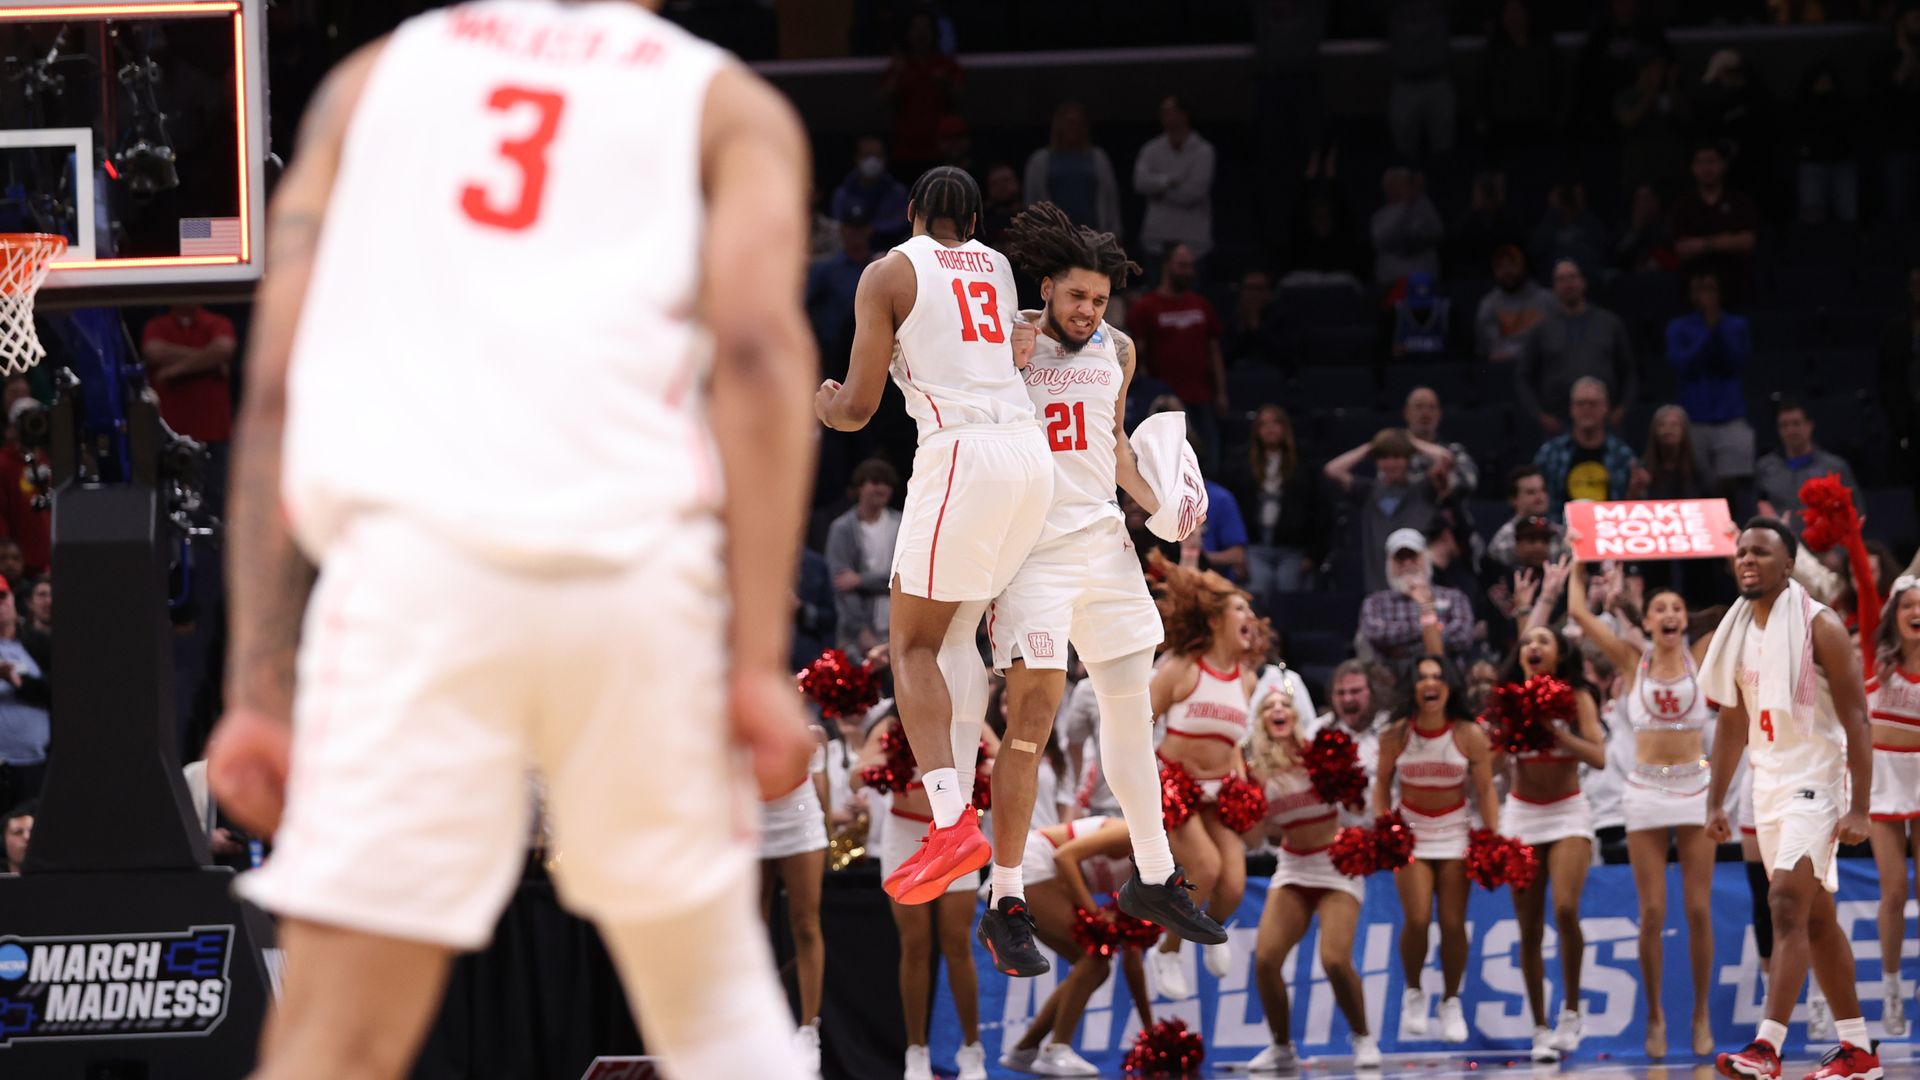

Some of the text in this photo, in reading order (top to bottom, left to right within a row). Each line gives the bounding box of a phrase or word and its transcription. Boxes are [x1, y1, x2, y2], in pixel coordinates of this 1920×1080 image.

[459, 85, 566, 232] 3
[934, 250, 994, 273] ROBERTS
[951, 278, 1005, 344] 13
[1044, 401, 1088, 452] 21
[1593, 502, 1703, 522] MAKE
[1595, 519, 1707, 538] SOME
[1595, 534, 1714, 555] NOISE
[1760, 709, 1774, 742] 4
[28, 941, 162, 983] MARCH
[44, 978, 223, 1022] MADNESS
